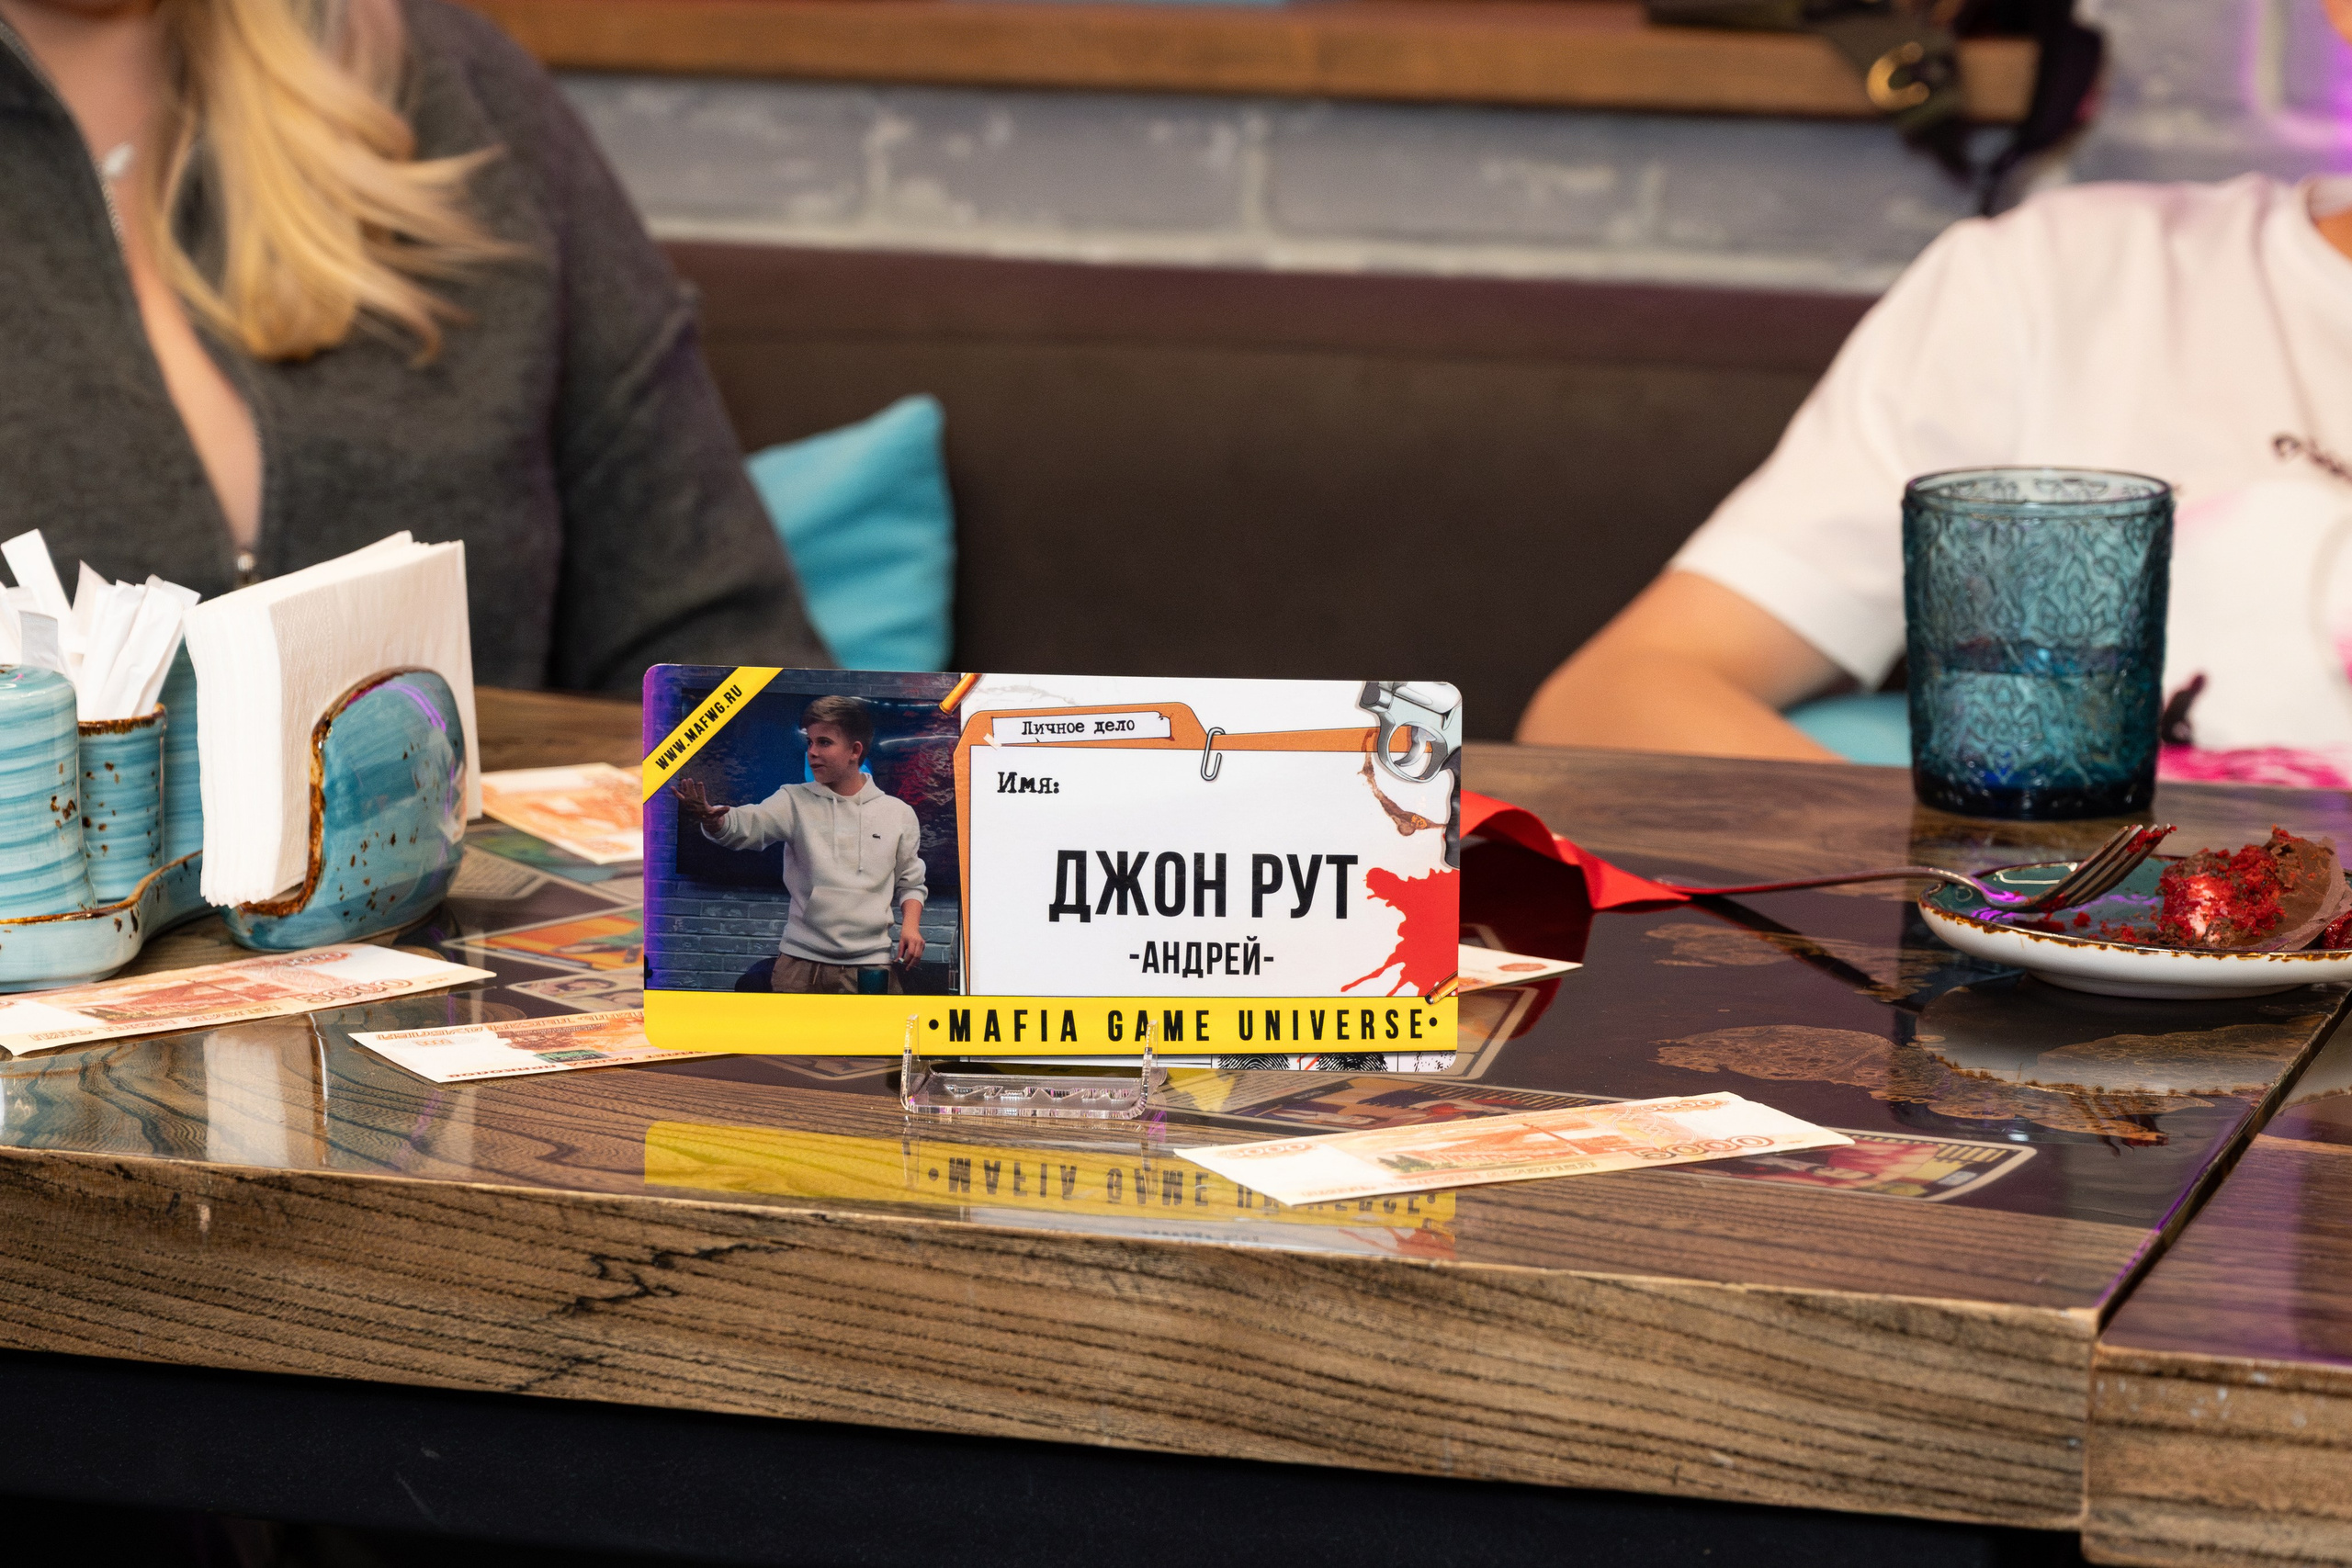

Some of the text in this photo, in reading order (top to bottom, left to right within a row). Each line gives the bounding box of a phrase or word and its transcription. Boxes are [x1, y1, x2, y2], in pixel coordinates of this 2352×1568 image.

[655, 684, 742, 770] WWW.MAFWG.RU
[1021, 719, 1136, 736] Личное дело
[997, 772, 1060, 794] Имя:
[1048, 850, 1359, 923] ДЖОН РУТ
[1129, 935, 1274, 978] -АНДРЕЙ-
[294, 978, 413, 1004] 5000
[1107, 1009, 1209, 1042] GAME
[1632, 1134, 1775, 1160] 5000
